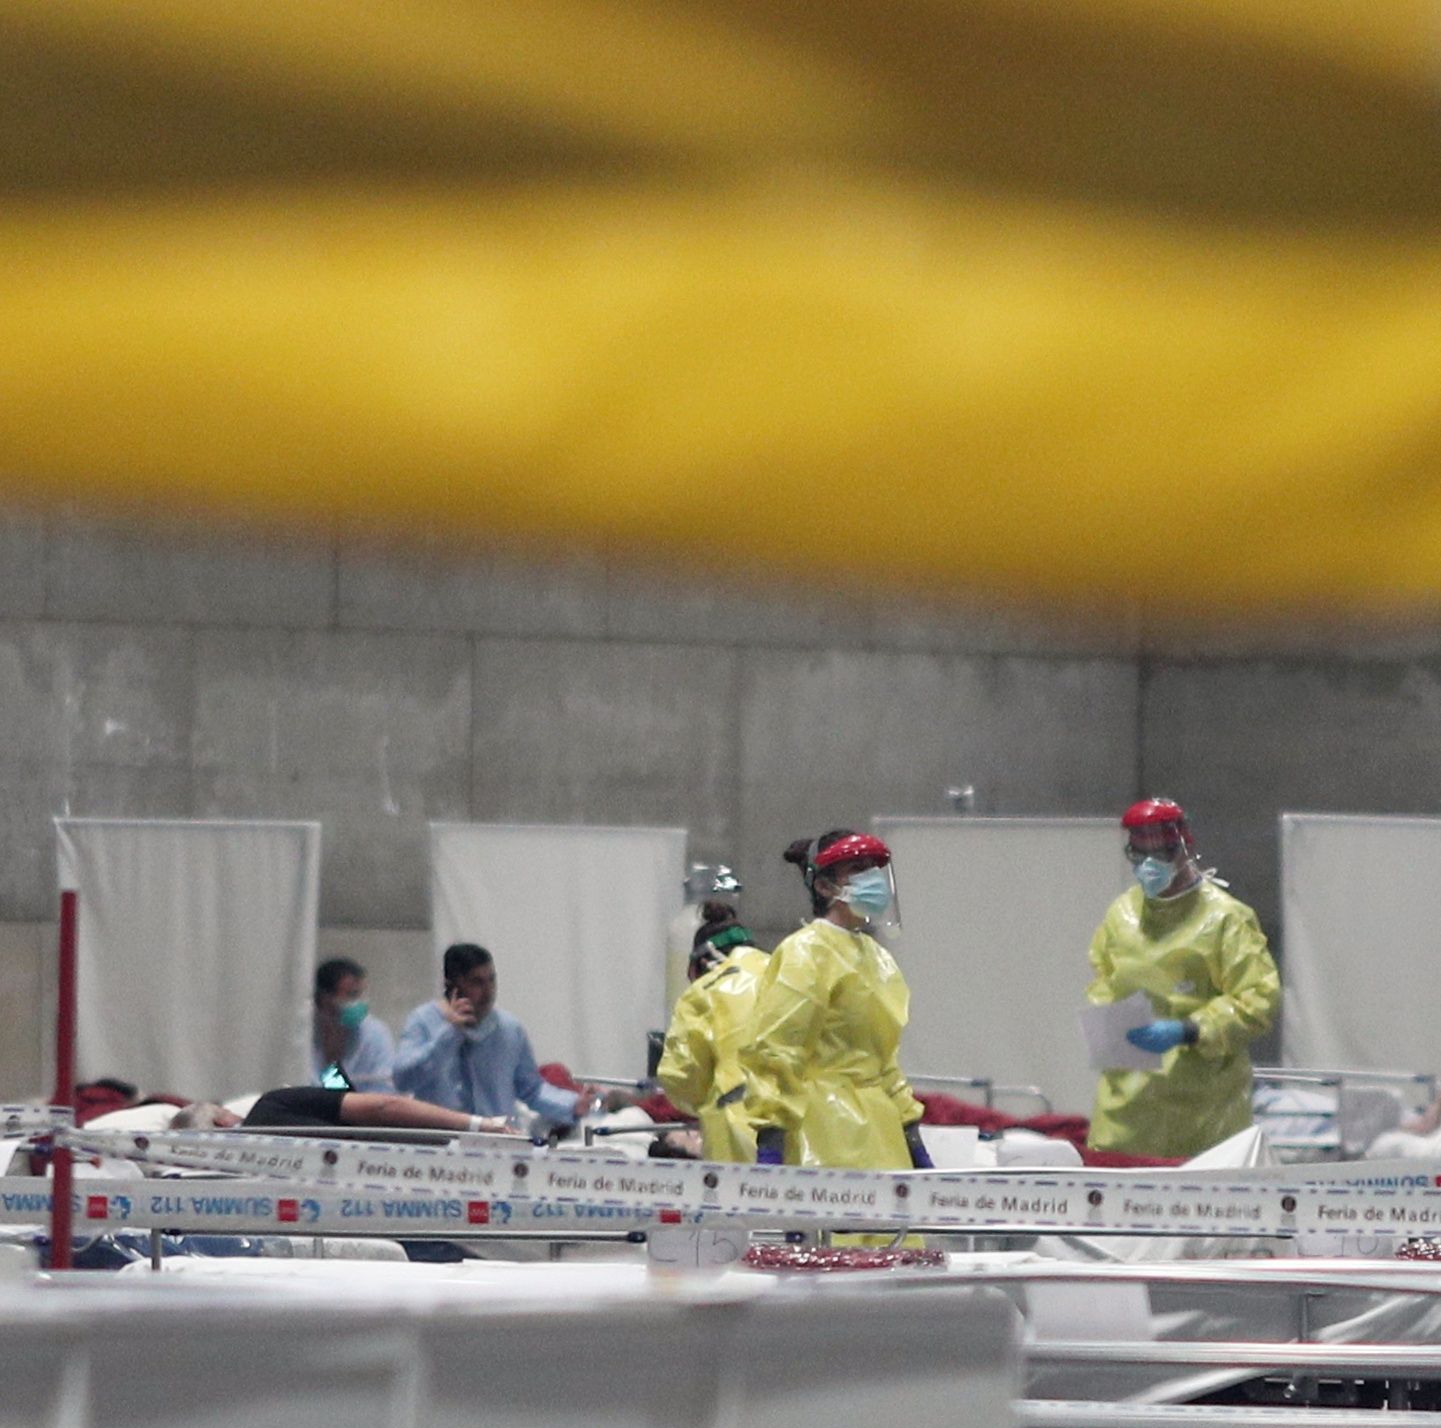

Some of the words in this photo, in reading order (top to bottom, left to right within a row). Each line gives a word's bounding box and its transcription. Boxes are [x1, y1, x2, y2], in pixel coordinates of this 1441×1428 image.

[358, 1159, 396, 1177] Feria
[404, 1164, 423, 1180] de
[430, 1167, 494, 1187] Madrid
[548, 1172, 587, 1190] Feria
[594, 1175, 614, 1192] de
[621, 1178, 685, 1196] Madrid
[740, 1182, 780, 1200] Feria
[785, 1184, 804, 1201] de
[811, 1187, 876, 1206] Madrid
[151, 1195, 182, 1214] 112
[192, 1196, 274, 1216] SUMMA
[340, 1200, 374, 1217] 112
[384, 1201, 462, 1219] SUMMA
[930, 1191, 969, 1209] Feria
[975, 1194, 995, 1211] de
[1002, 1196, 1068, 1215] Madrid
[1123, 1200, 1164, 1217] Feria
[1170, 1202, 1190, 1219] de
[1197, 1202, 1262, 1220] Madrid
[1317, 1204, 1358, 1220] Feria
[1364, 1205, 1384, 1221] de
